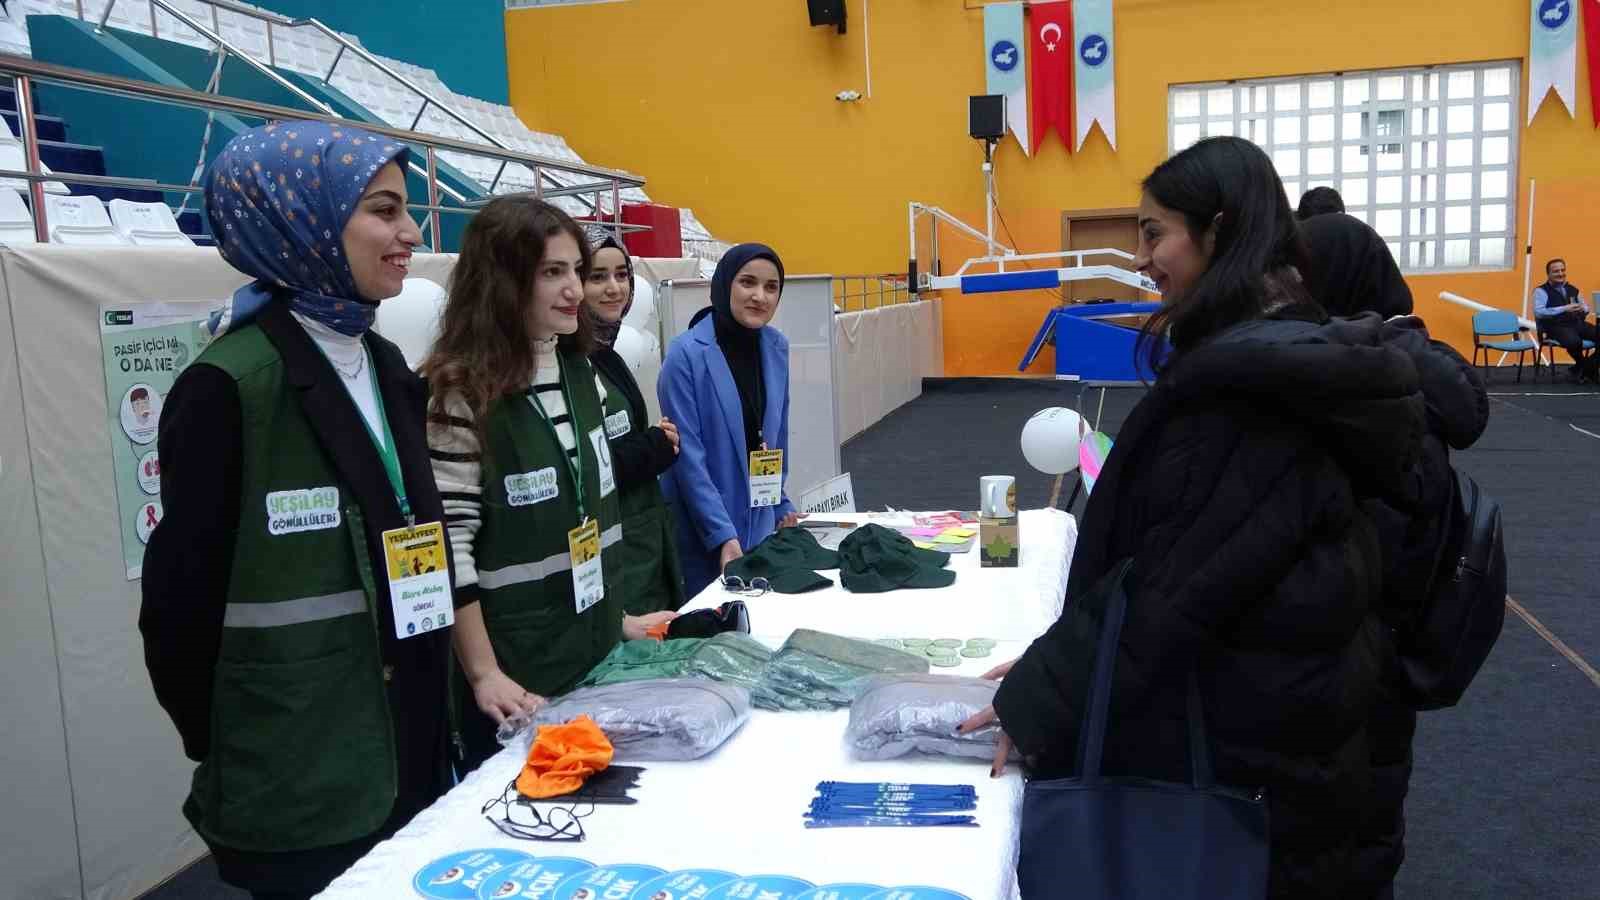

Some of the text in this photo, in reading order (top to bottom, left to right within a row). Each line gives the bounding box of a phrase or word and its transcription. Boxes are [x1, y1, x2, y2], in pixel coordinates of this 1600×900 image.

[120, 358, 131, 372] O
[134, 358, 153, 372] DA
[155, 357, 173, 372] NE
[270, 491, 337, 514] YEŞİLAY
[272, 511, 337, 531] GÖNÜLLÜLERİ
